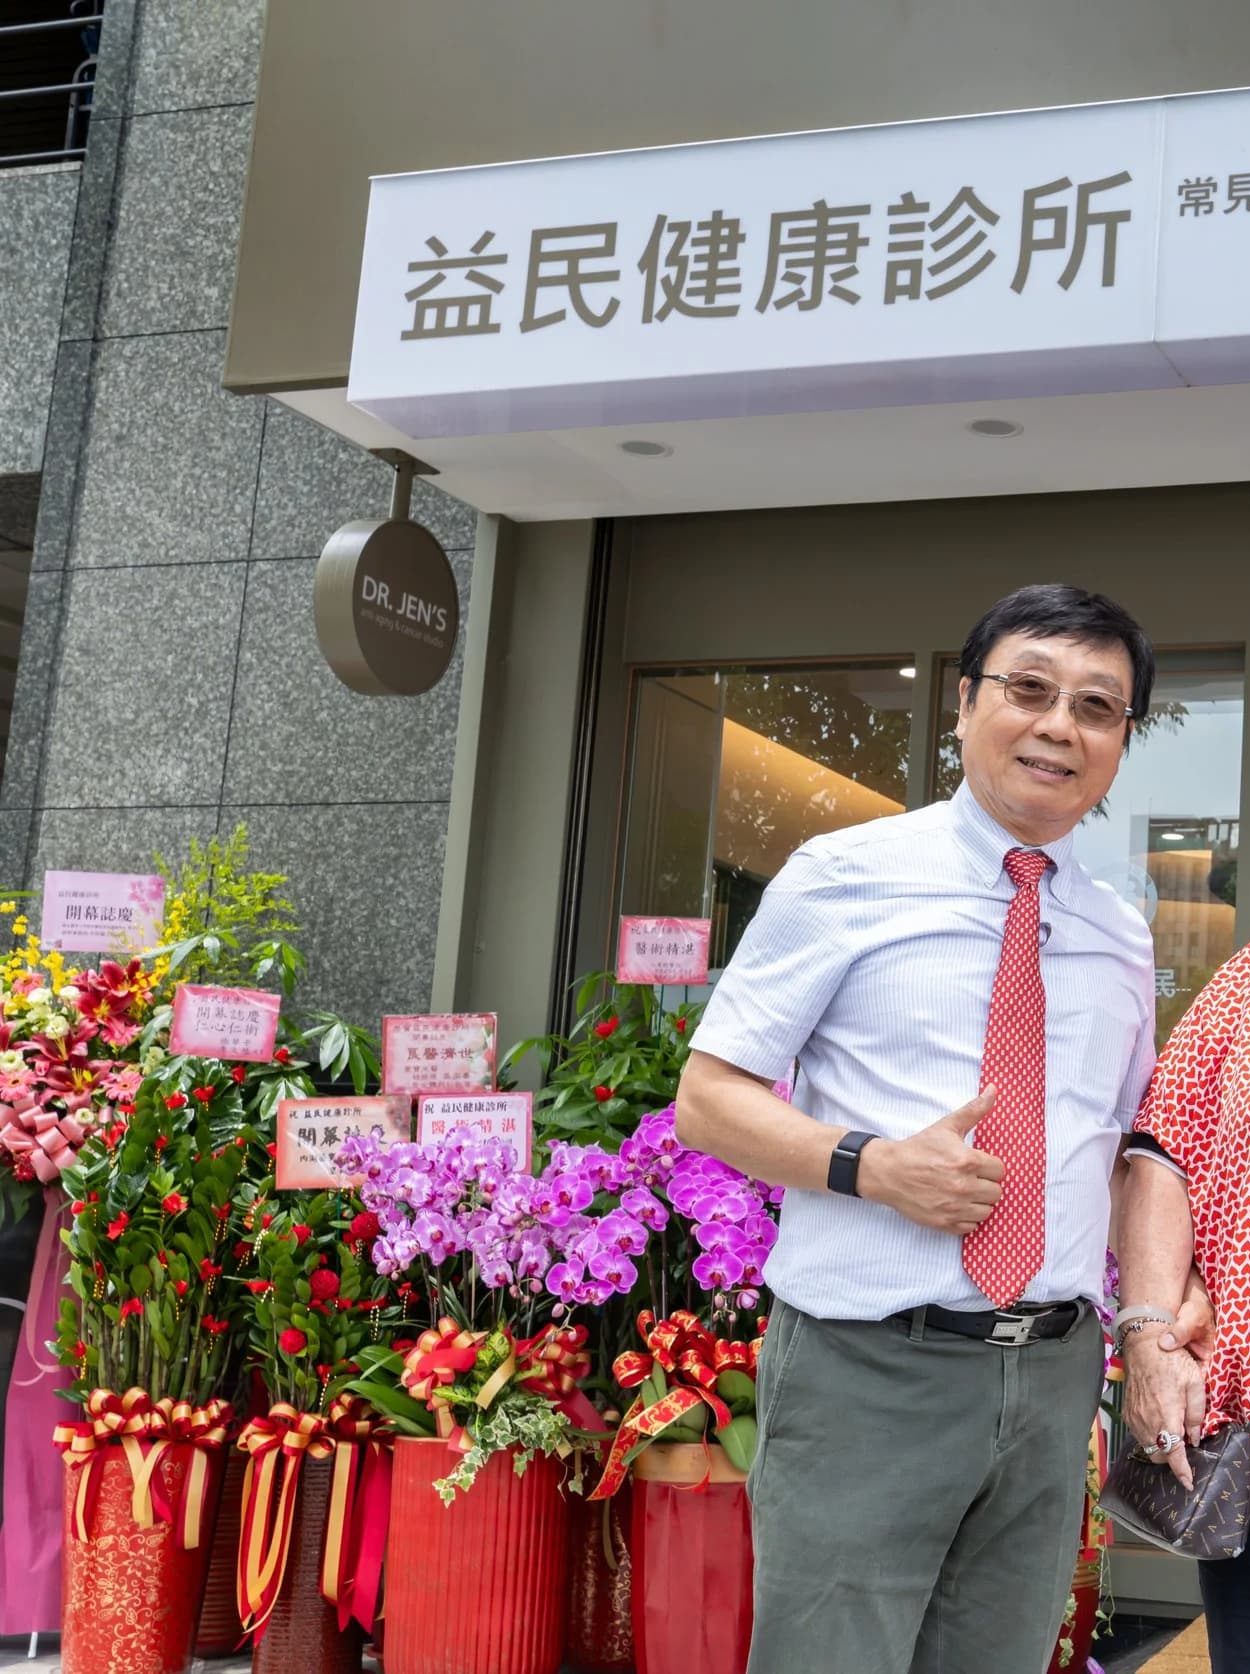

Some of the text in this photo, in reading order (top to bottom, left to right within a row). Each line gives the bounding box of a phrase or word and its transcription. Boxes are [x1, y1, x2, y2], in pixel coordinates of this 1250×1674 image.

[400, 170, 1132, 341] 益民健康診所
[362, 575, 393, 611] DR.
[396, 591, 447, 632] JEN'S
[65, 905, 133, 922] 開幕誌慶
[289, 1107, 362, 1119] 祝 益民健康診所
[425, 1101, 507, 1114] 祝 益民健康診所
